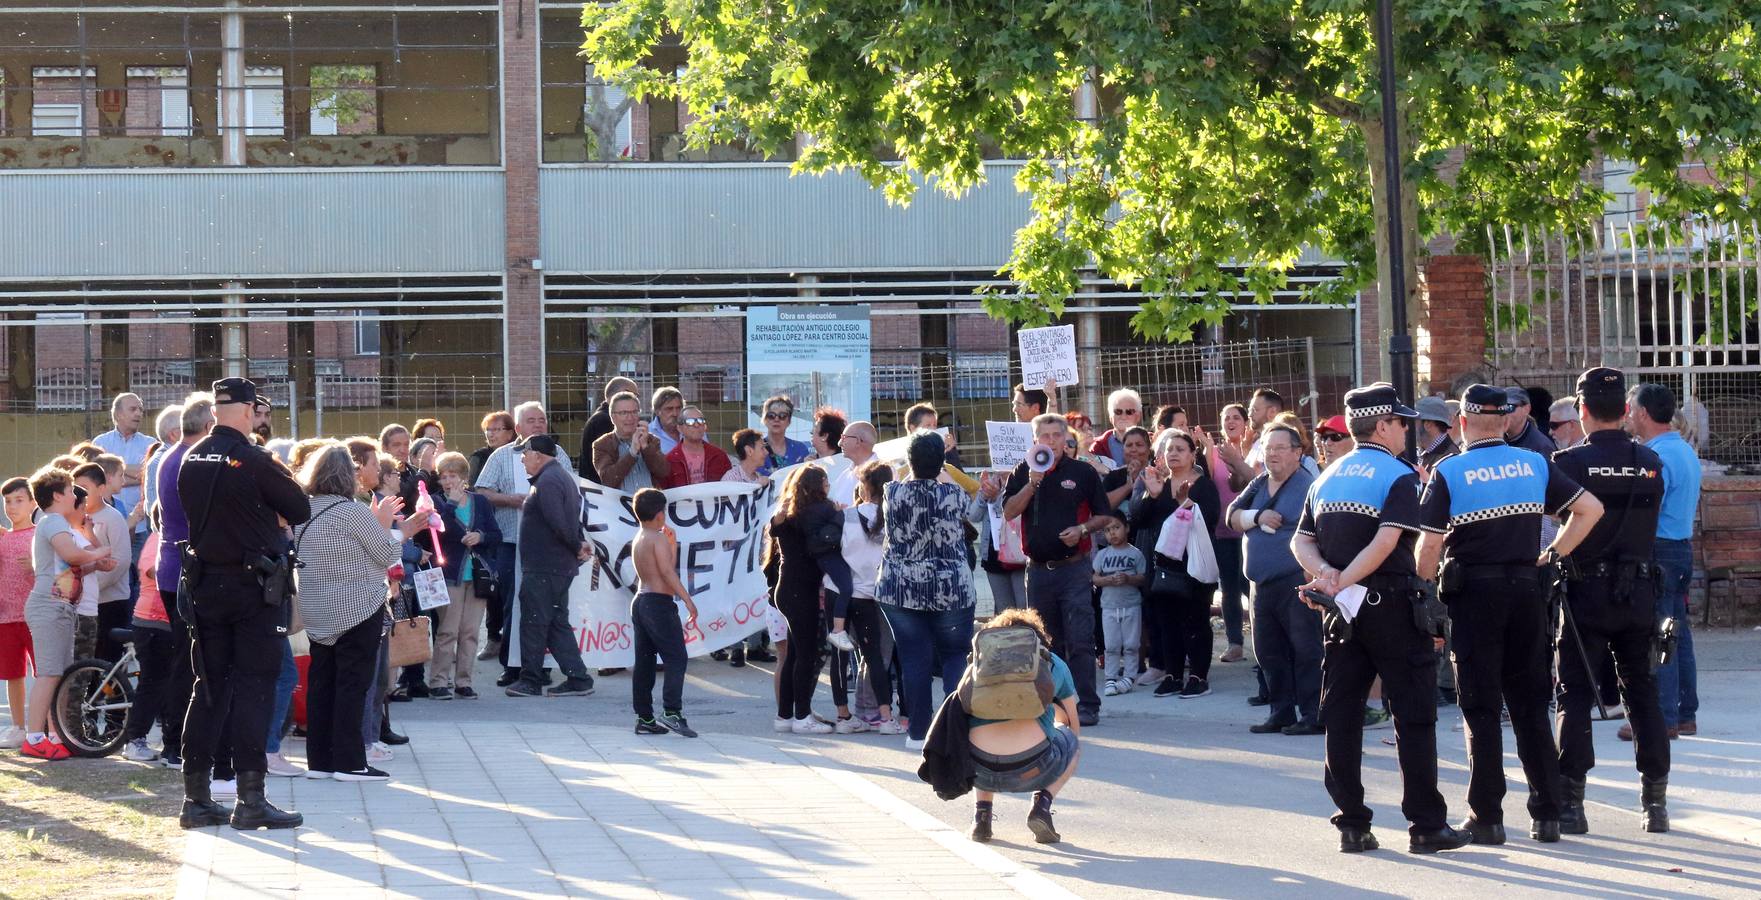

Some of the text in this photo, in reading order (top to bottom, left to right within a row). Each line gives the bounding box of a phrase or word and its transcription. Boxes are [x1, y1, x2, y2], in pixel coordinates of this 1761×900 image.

[780, 312, 796, 320] Obra
[806, 312, 837, 321] ejecución
[755, 323, 860, 333] REHABILITACIÓN ANTIGUO COLEGIO
[750, 332, 781, 342] SANTIAGO
[804, 332, 822, 341] PARA
[822, 332, 846, 341] CENTRO
[847, 331, 869, 341] SOCIAL
[1039, 328, 1065, 340] SANTIAGO
[1044, 361, 1053, 370] UN
[1000, 426, 1015, 435] SIN
[1464, 459, 1535, 486] POLICÍA
[1102, 555, 1136, 569] NIKE
[708, 617, 727, 632] DE
